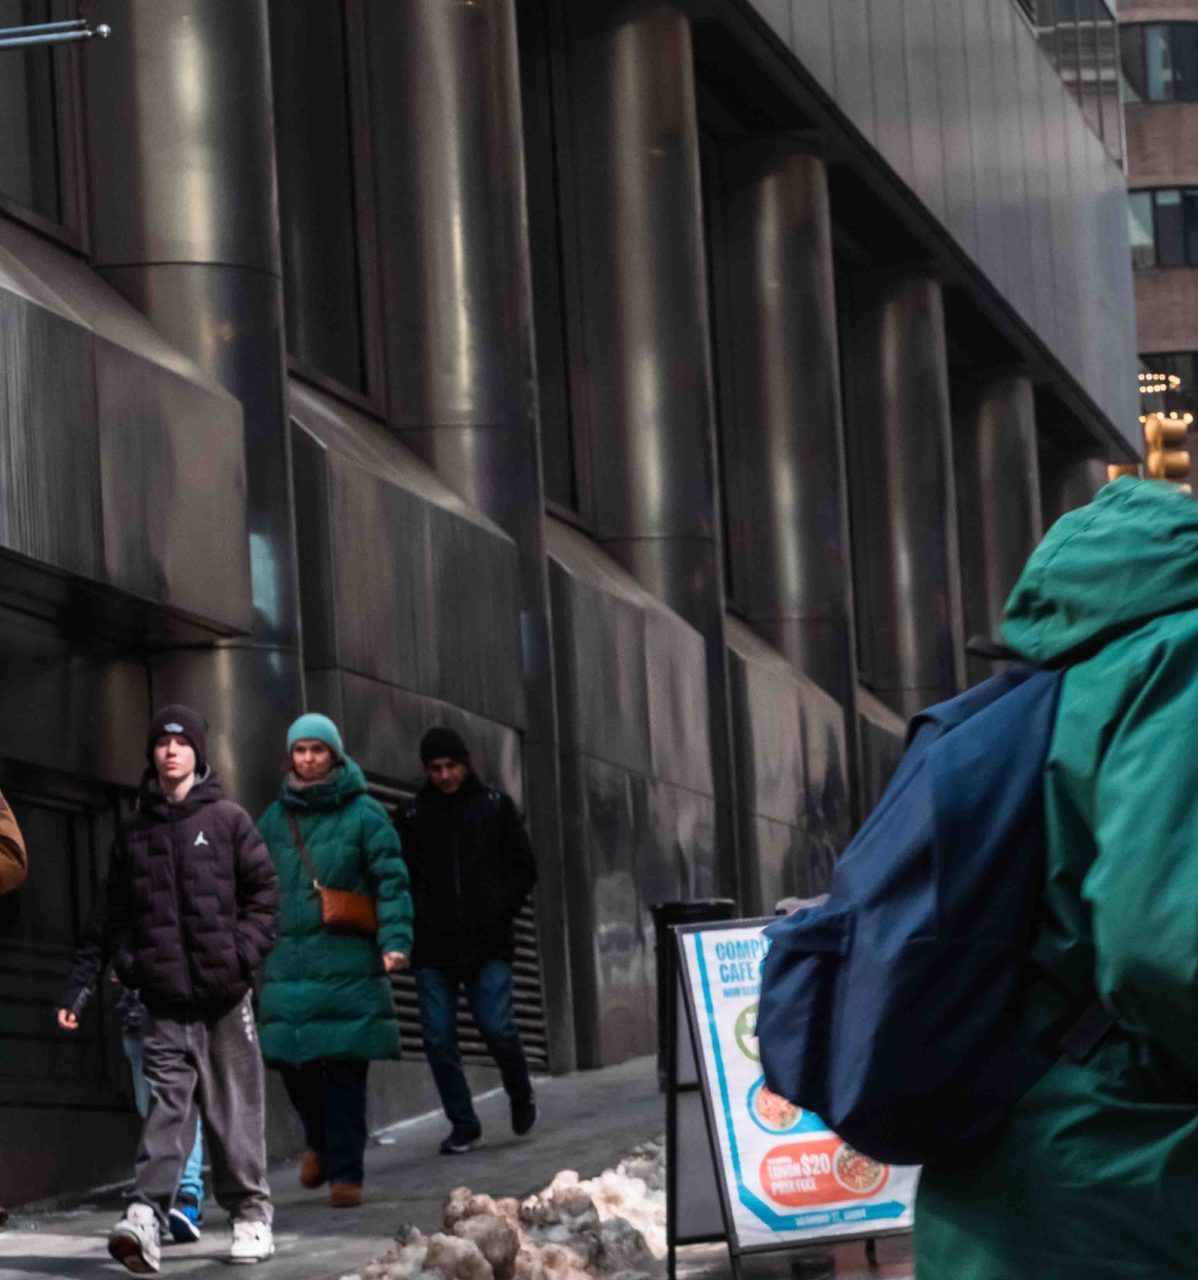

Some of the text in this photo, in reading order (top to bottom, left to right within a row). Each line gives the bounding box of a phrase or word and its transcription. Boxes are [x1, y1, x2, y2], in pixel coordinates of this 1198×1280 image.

[720, 961, 755, 983] CAFE
[768, 1164, 801, 1179] LUNCH
[800, 1152, 831, 1176] $20
[771, 1178, 797, 1194] PRIX
